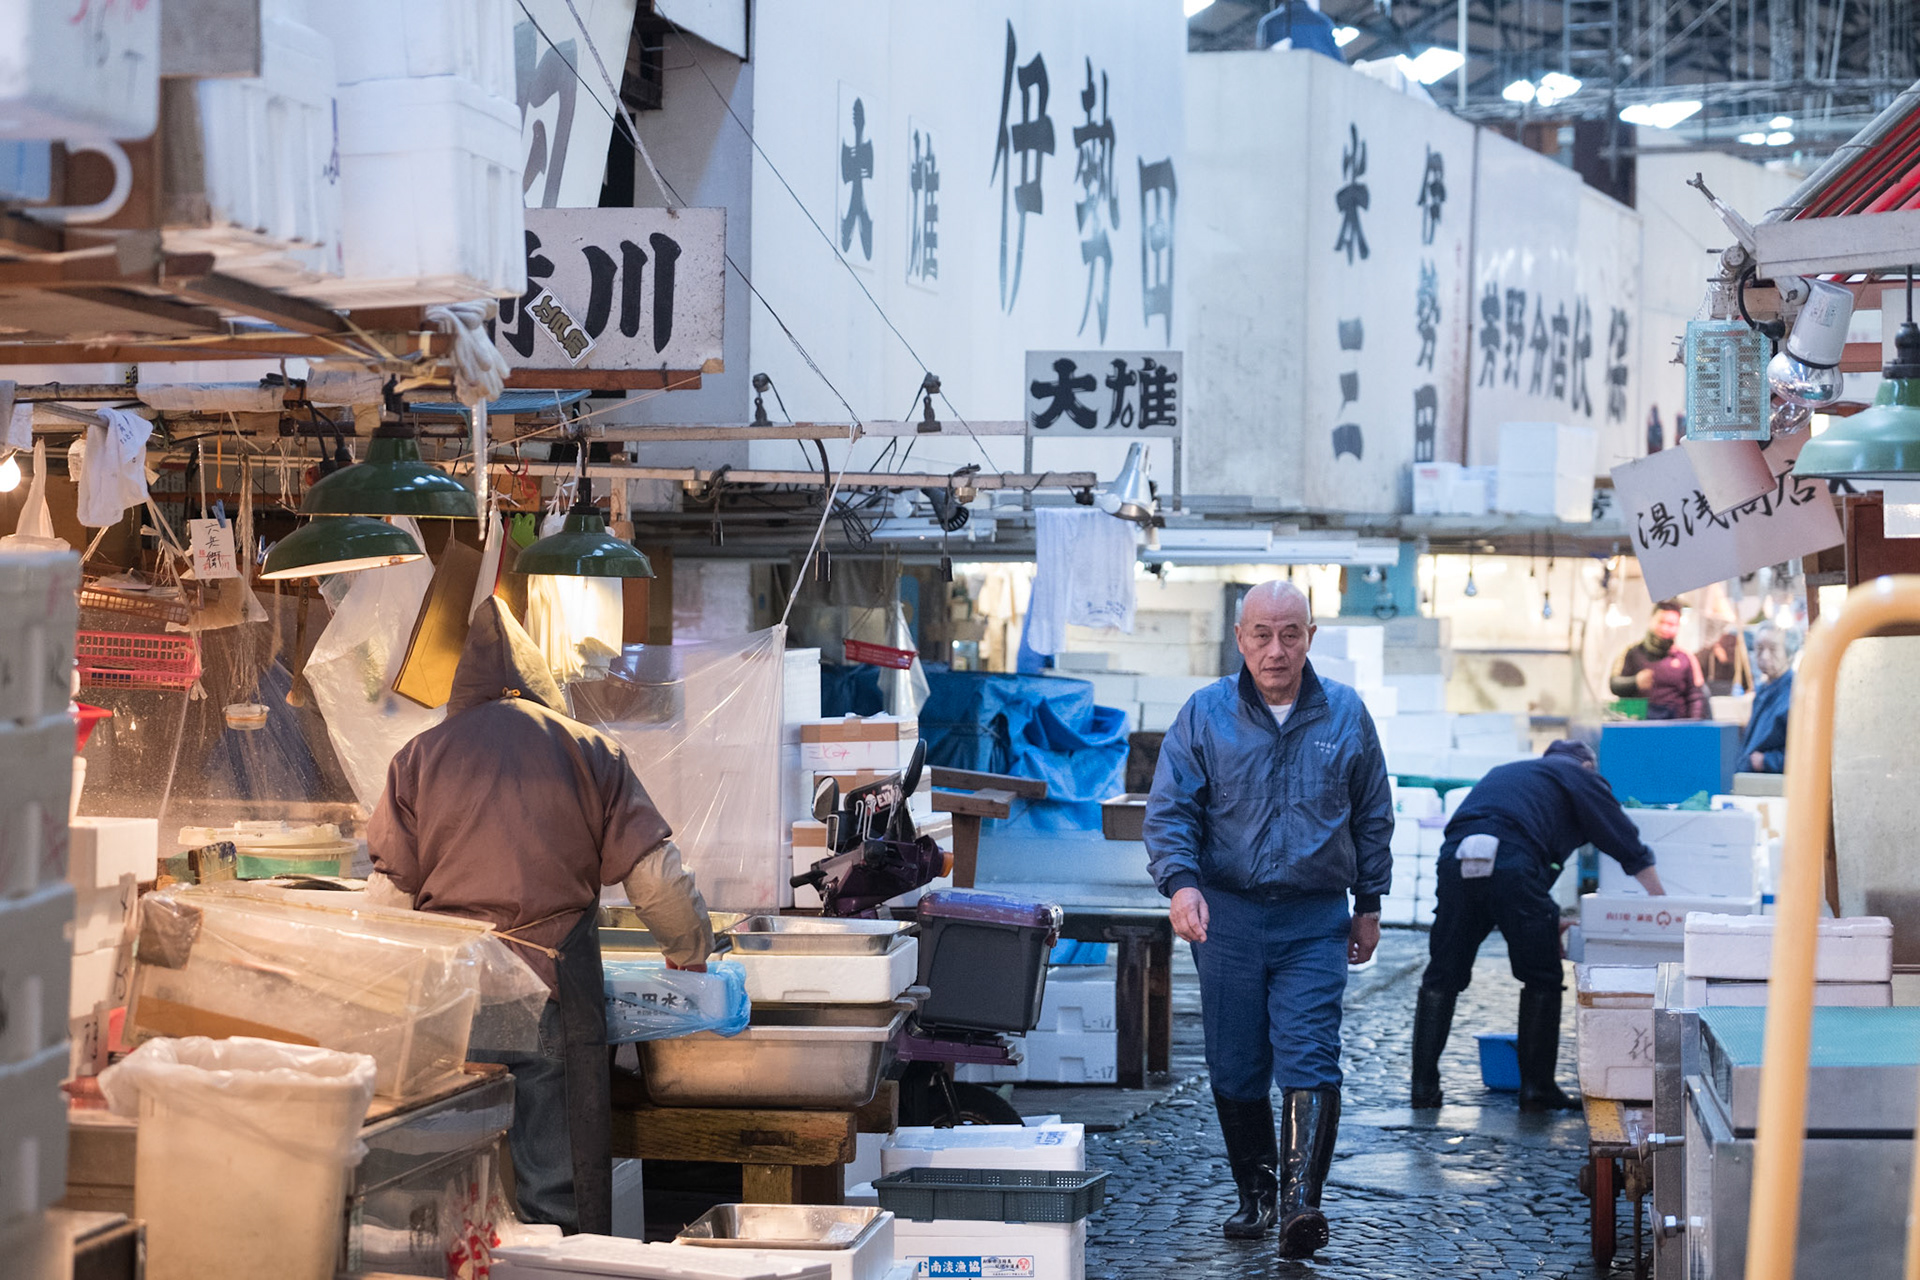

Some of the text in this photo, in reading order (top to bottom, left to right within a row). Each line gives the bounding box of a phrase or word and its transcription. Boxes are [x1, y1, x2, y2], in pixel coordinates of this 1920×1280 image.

[531, 294, 590, 359] 江戸前
[1030, 357, 1178, 430] 大雄
